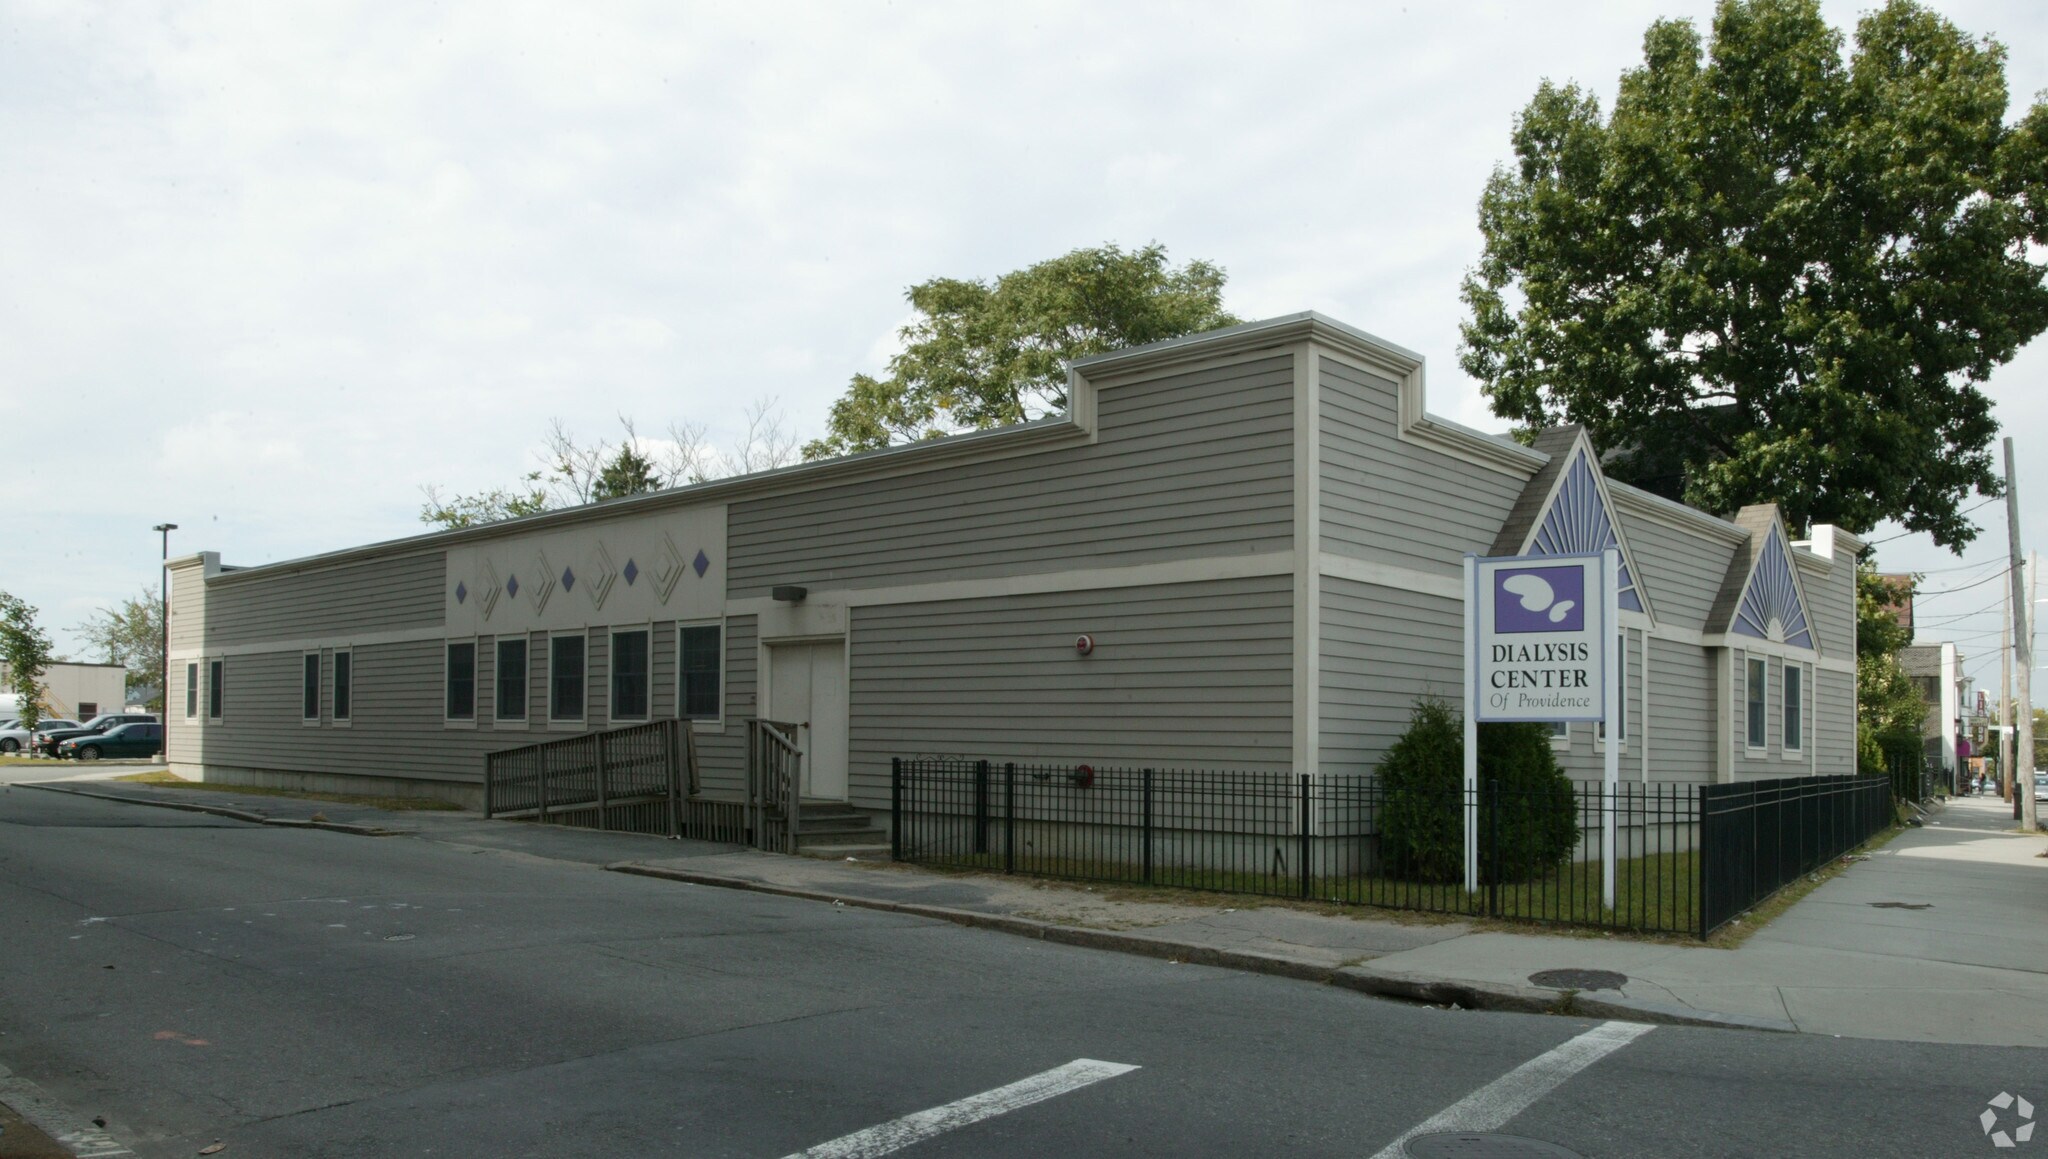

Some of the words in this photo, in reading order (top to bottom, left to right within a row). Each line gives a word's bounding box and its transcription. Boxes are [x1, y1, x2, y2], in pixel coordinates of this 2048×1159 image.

[1492, 642, 1589, 663] DIALYSIS
[1491, 669, 1589, 688] CENTER
[1490, 692, 1509, 711] Of
[1518, 692, 1590, 708] Providence
